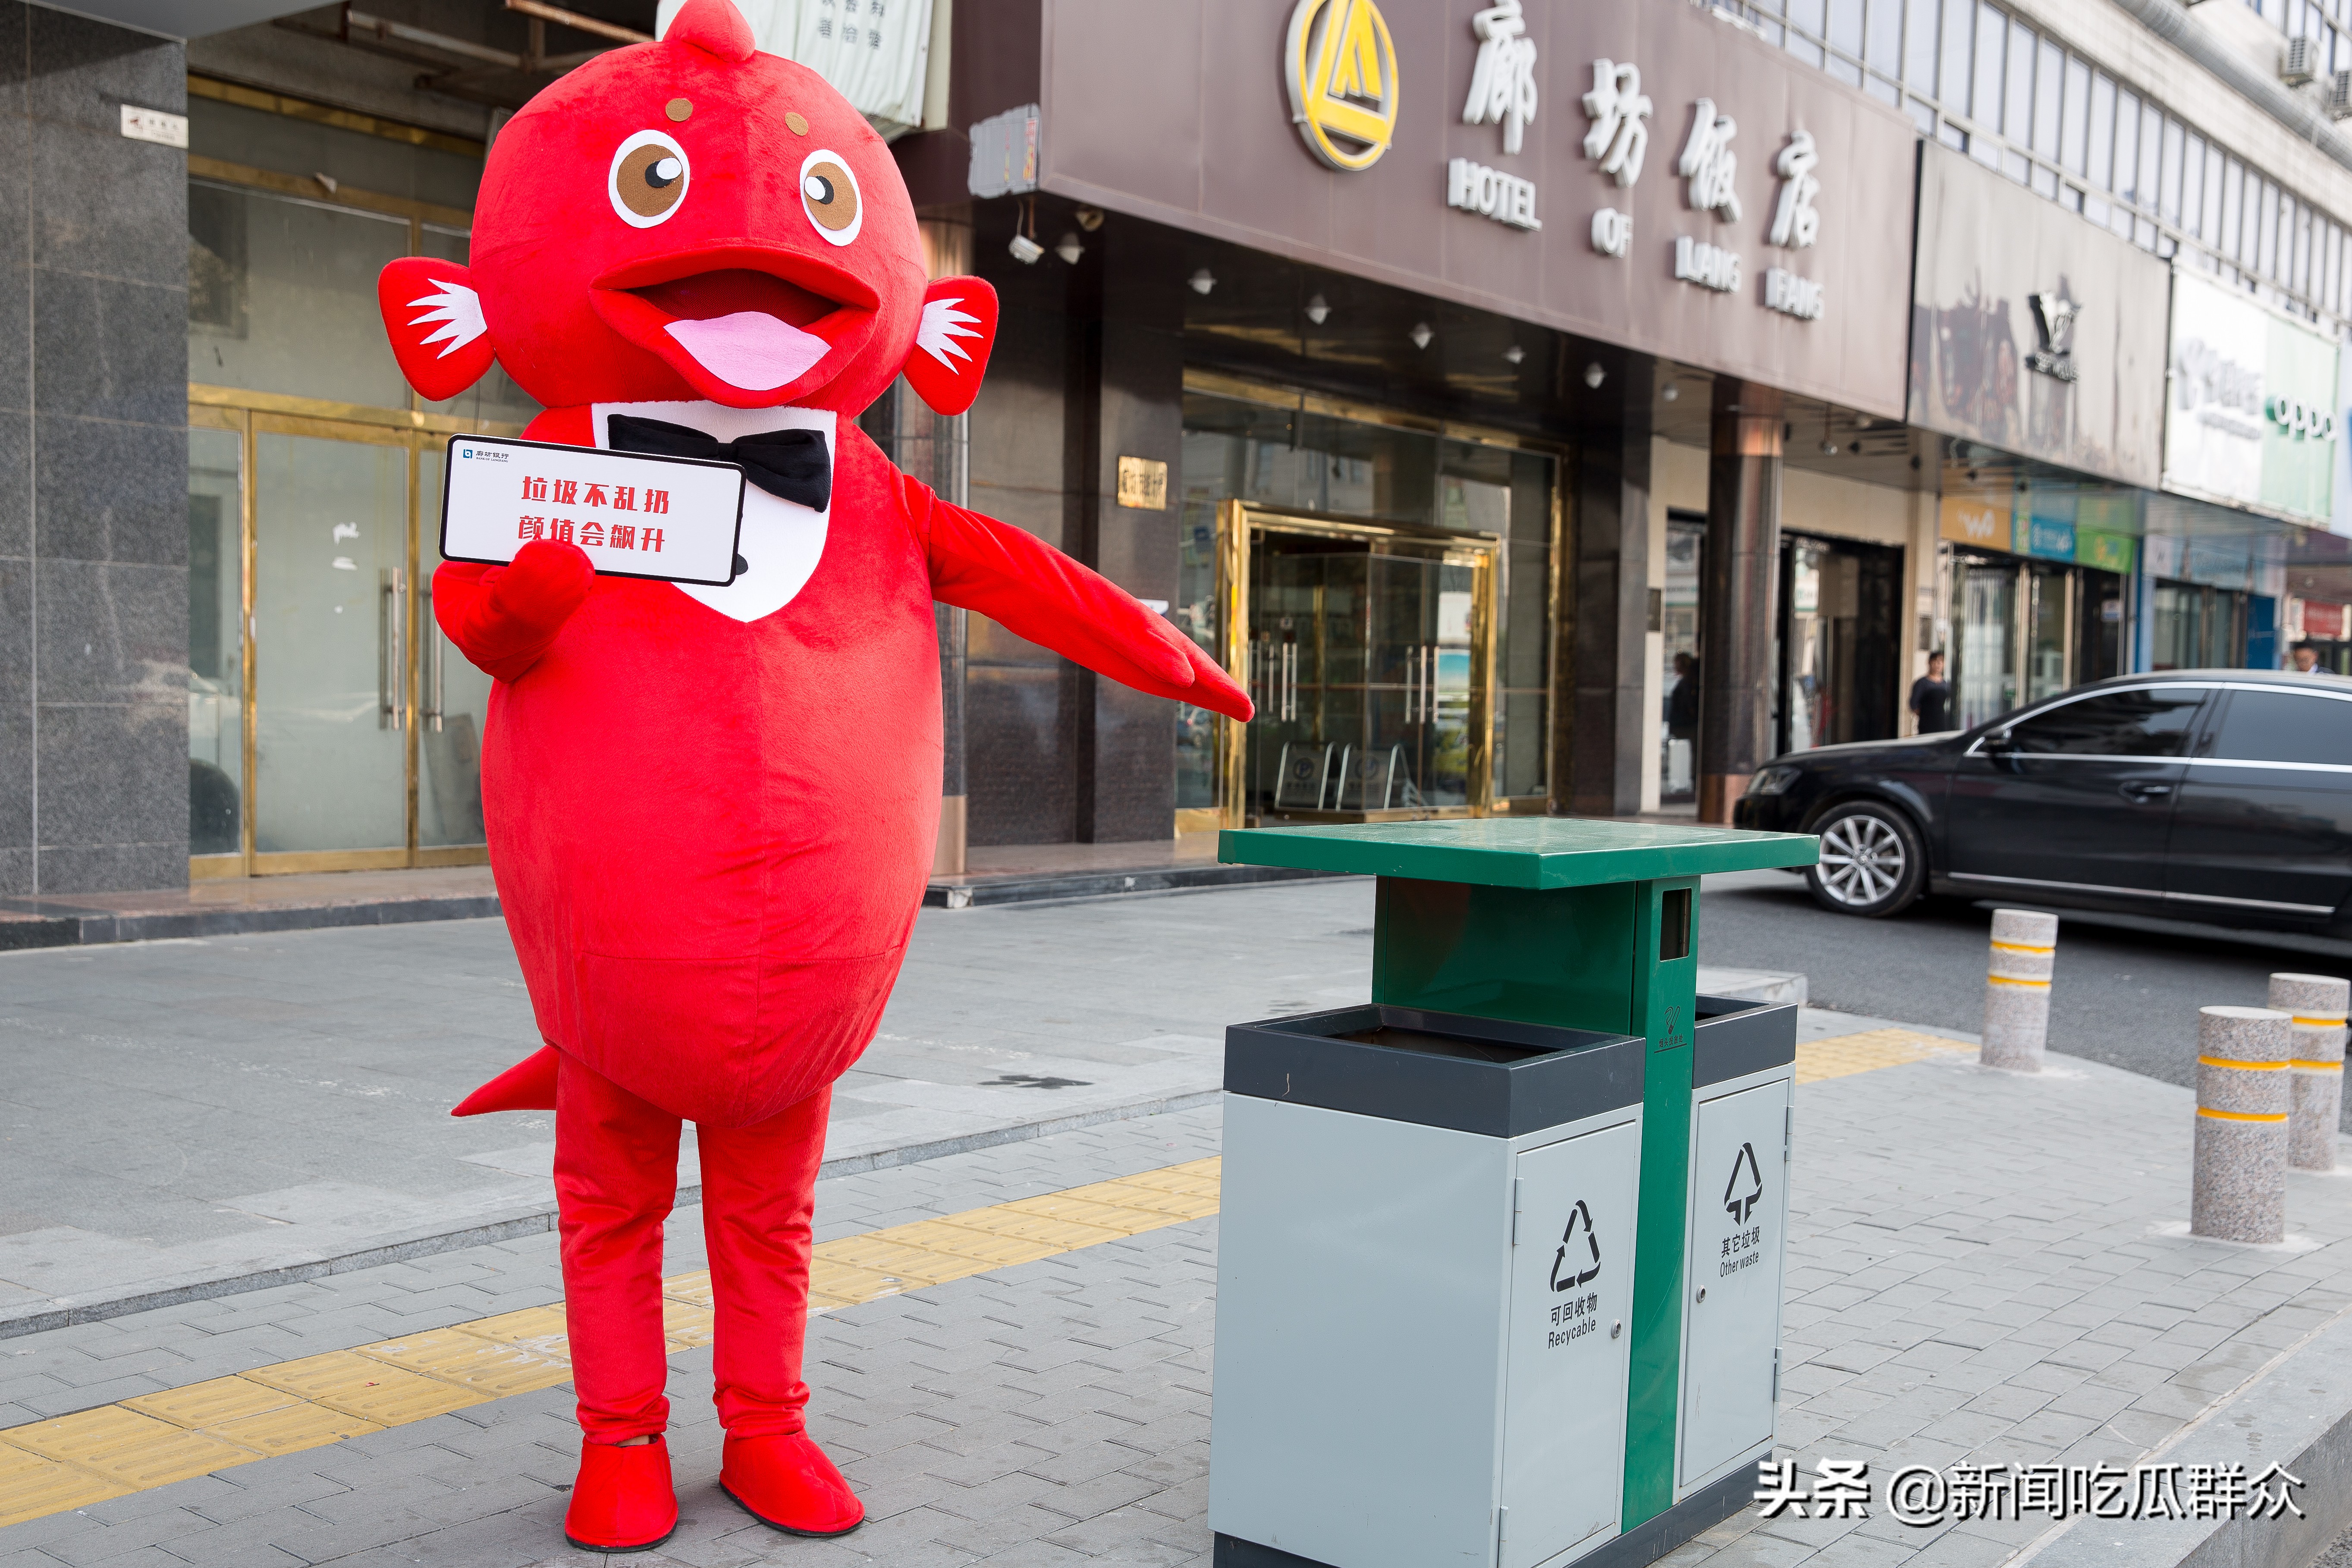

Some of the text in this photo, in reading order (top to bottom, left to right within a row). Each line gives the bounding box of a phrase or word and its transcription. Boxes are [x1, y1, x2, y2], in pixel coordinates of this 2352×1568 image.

[1463, 0, 1820, 248] 廊坊饭店
[1448, 157, 1824, 321] HOTEL OF LANG FANG
[521, 476, 669, 514] 垃圾不乱扔
[518, 515, 665, 552] 颜值会飙升
[1658, 1034, 1683, 1048] 烟头投放处
[1721, 1225, 1760, 1259] 其它垃圾
[1720, 1250, 1759, 1278] Other waste
[1551, 1291, 1598, 1326] 可回收物
[1548, 1316, 1596, 1349] Recycable
